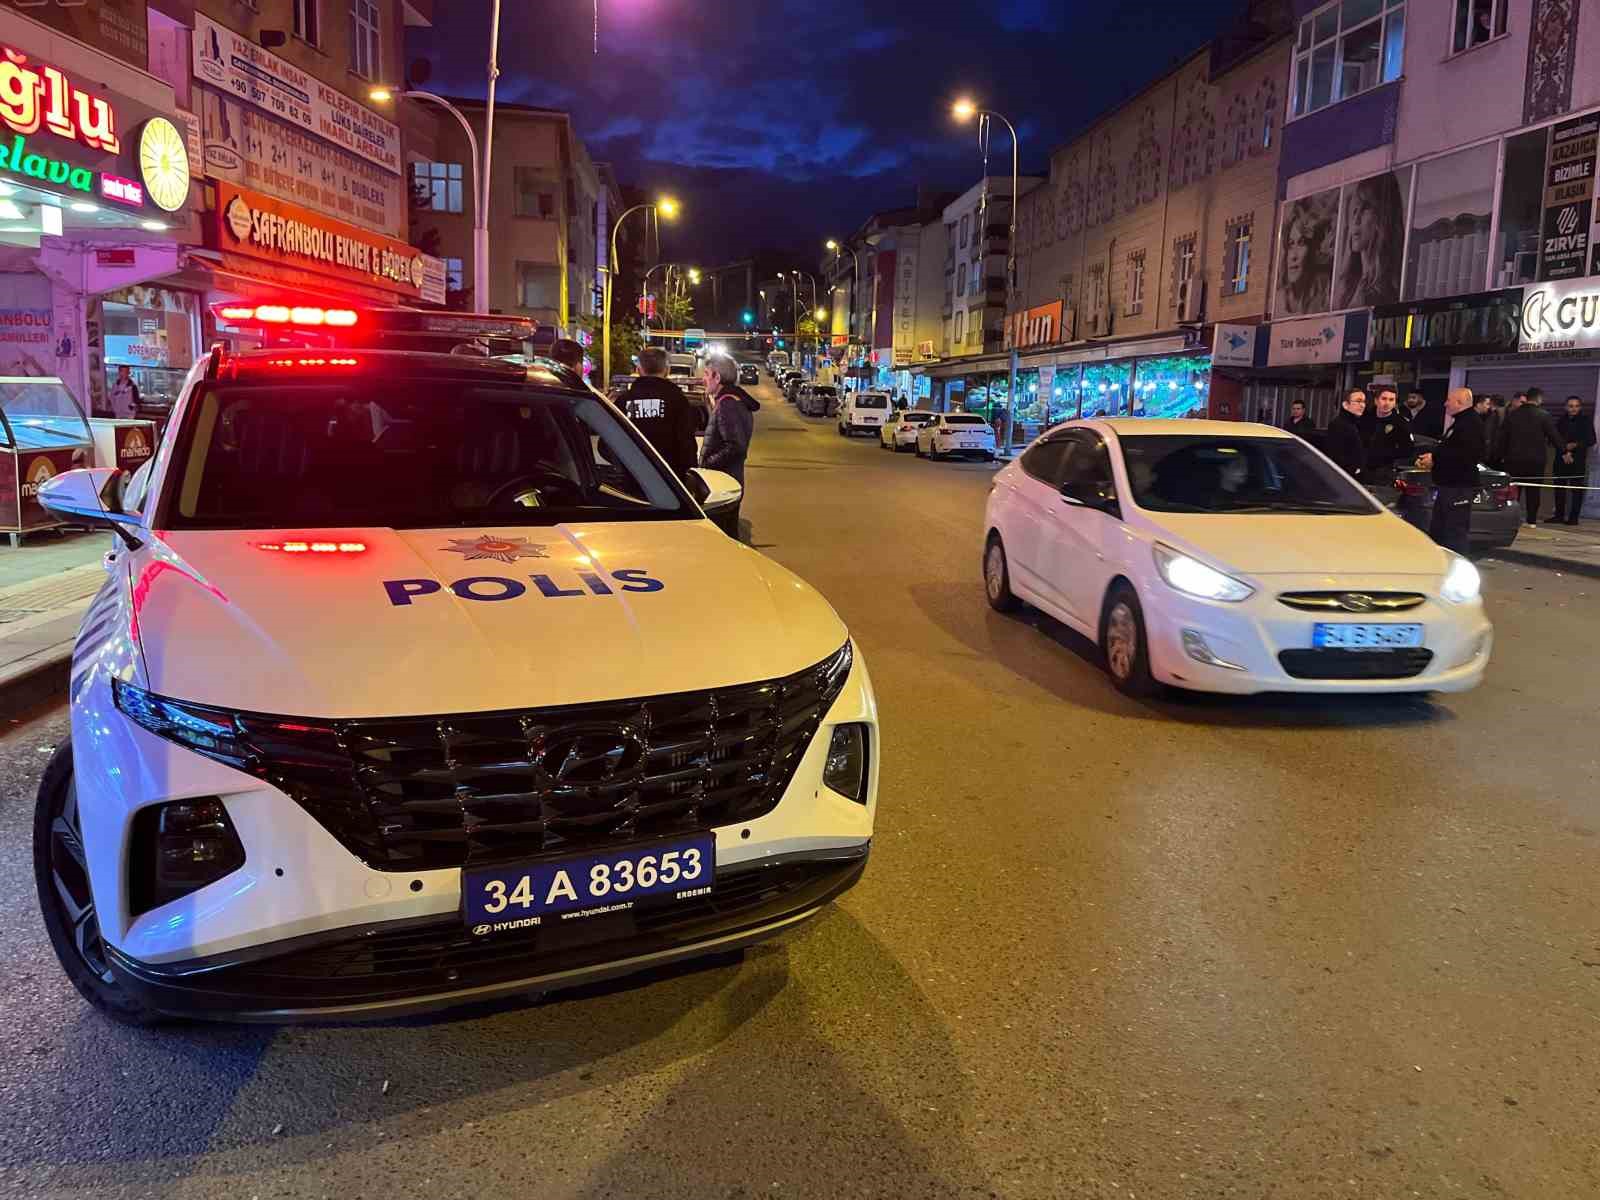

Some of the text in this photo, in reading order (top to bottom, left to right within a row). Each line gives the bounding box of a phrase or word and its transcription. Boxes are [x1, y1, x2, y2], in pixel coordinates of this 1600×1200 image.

[246, 133, 263, 160] 1+1
[271, 144, 287, 169] 2+1
[1554, 162, 1590, 183] BİZİMLE
[252, 208, 334, 262] SAFRANBOLU
[335, 234, 370, 273] EKMEK
[383, 568, 665, 606] POLİS
[484, 848, 702, 913] 34 A 83653
[493, 916, 541, 932] HYUNDAI
[561, 902, 635, 919] www.hyundai.com.tr
